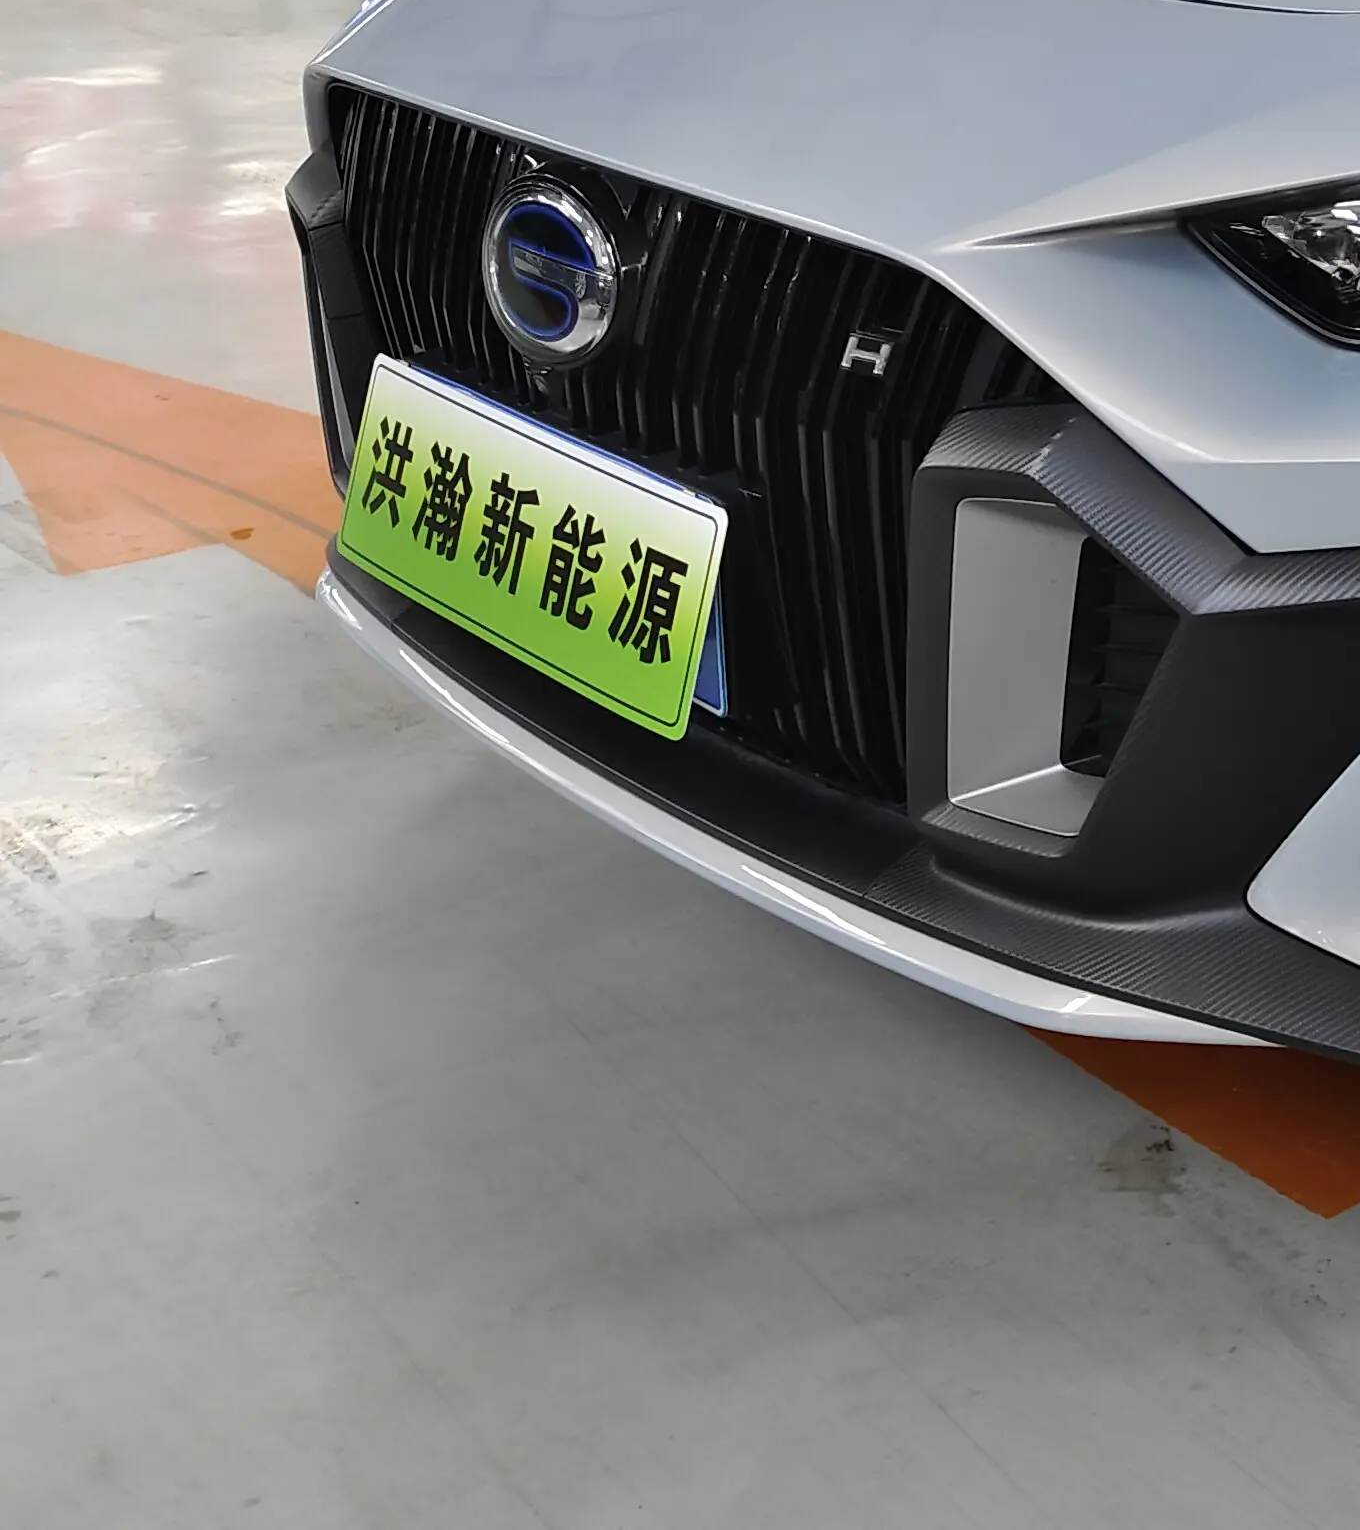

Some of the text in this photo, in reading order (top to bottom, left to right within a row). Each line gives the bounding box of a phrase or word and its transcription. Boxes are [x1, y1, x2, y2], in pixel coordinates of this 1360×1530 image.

[360, 415, 690, 666] 洪瀚新能源
